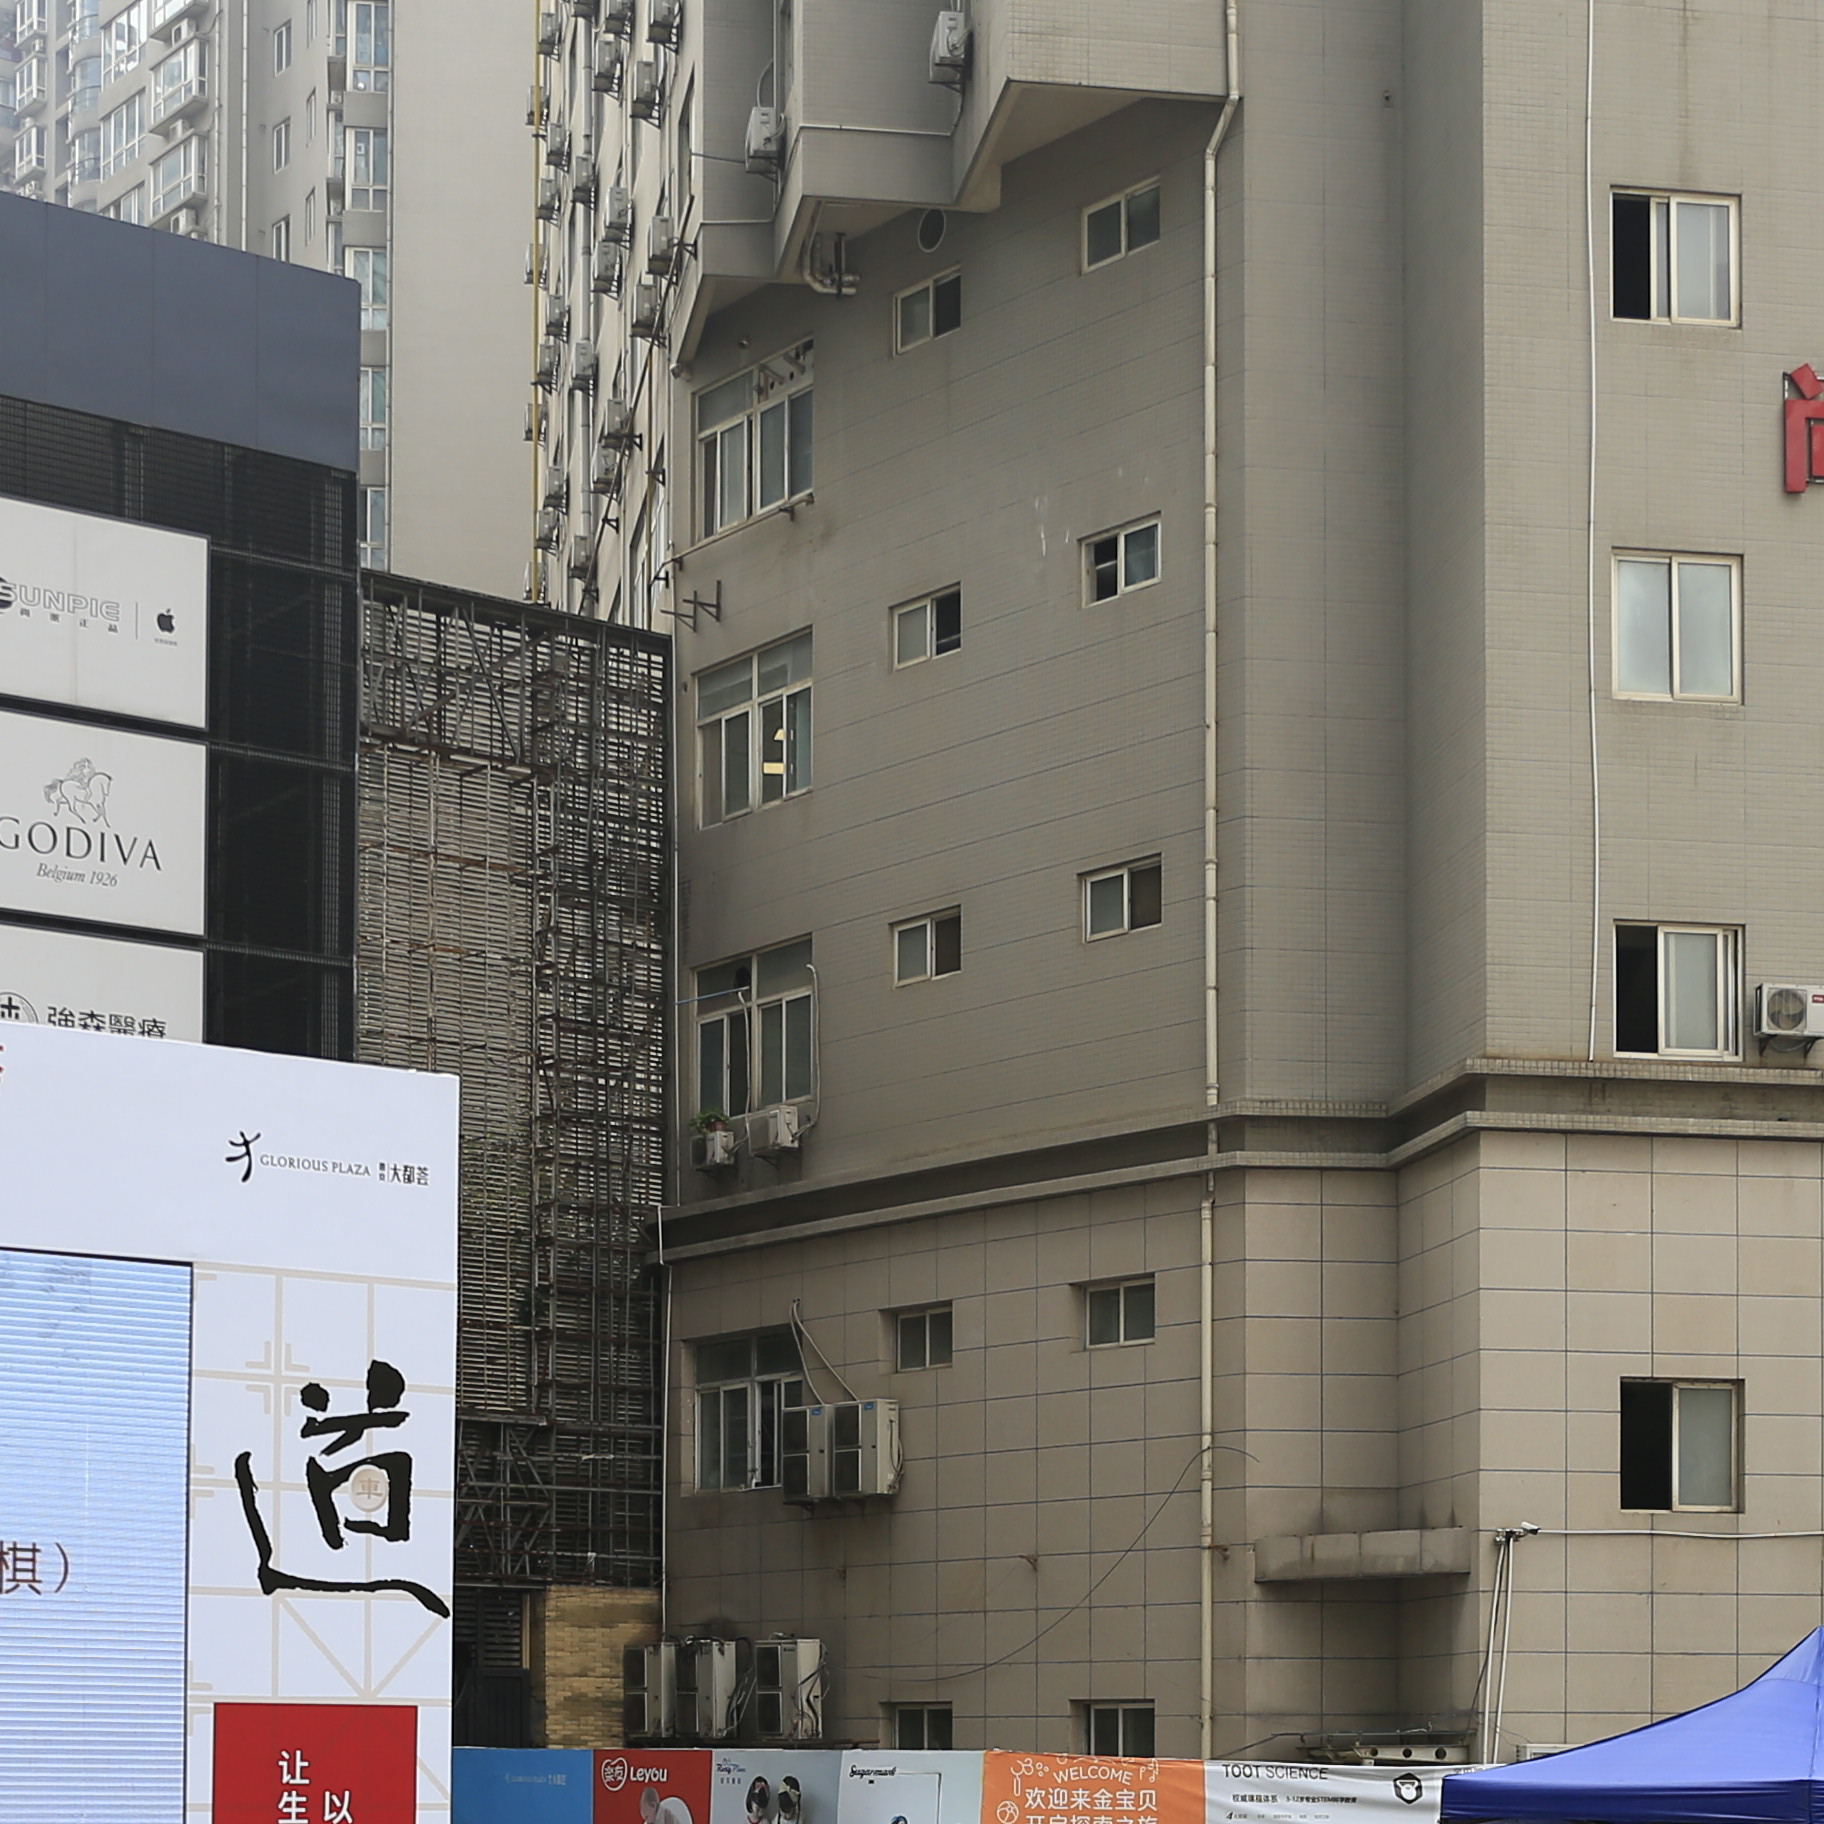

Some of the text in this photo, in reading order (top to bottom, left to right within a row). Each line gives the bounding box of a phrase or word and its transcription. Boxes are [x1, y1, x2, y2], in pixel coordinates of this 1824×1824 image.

[35, 862, 119, 889] Belgium 1926
[260, 1154, 371, 1177] GLORIOUS PLAZA
[630, 1766, 667, 1783] Leyou
[1052, 1765, 1133, 1787] WELCOME
[1222, 1764, 1328, 1780] TOOT SCIENCE
[1024, 1787, 1158, 1813] 欢迎来金宝贝
